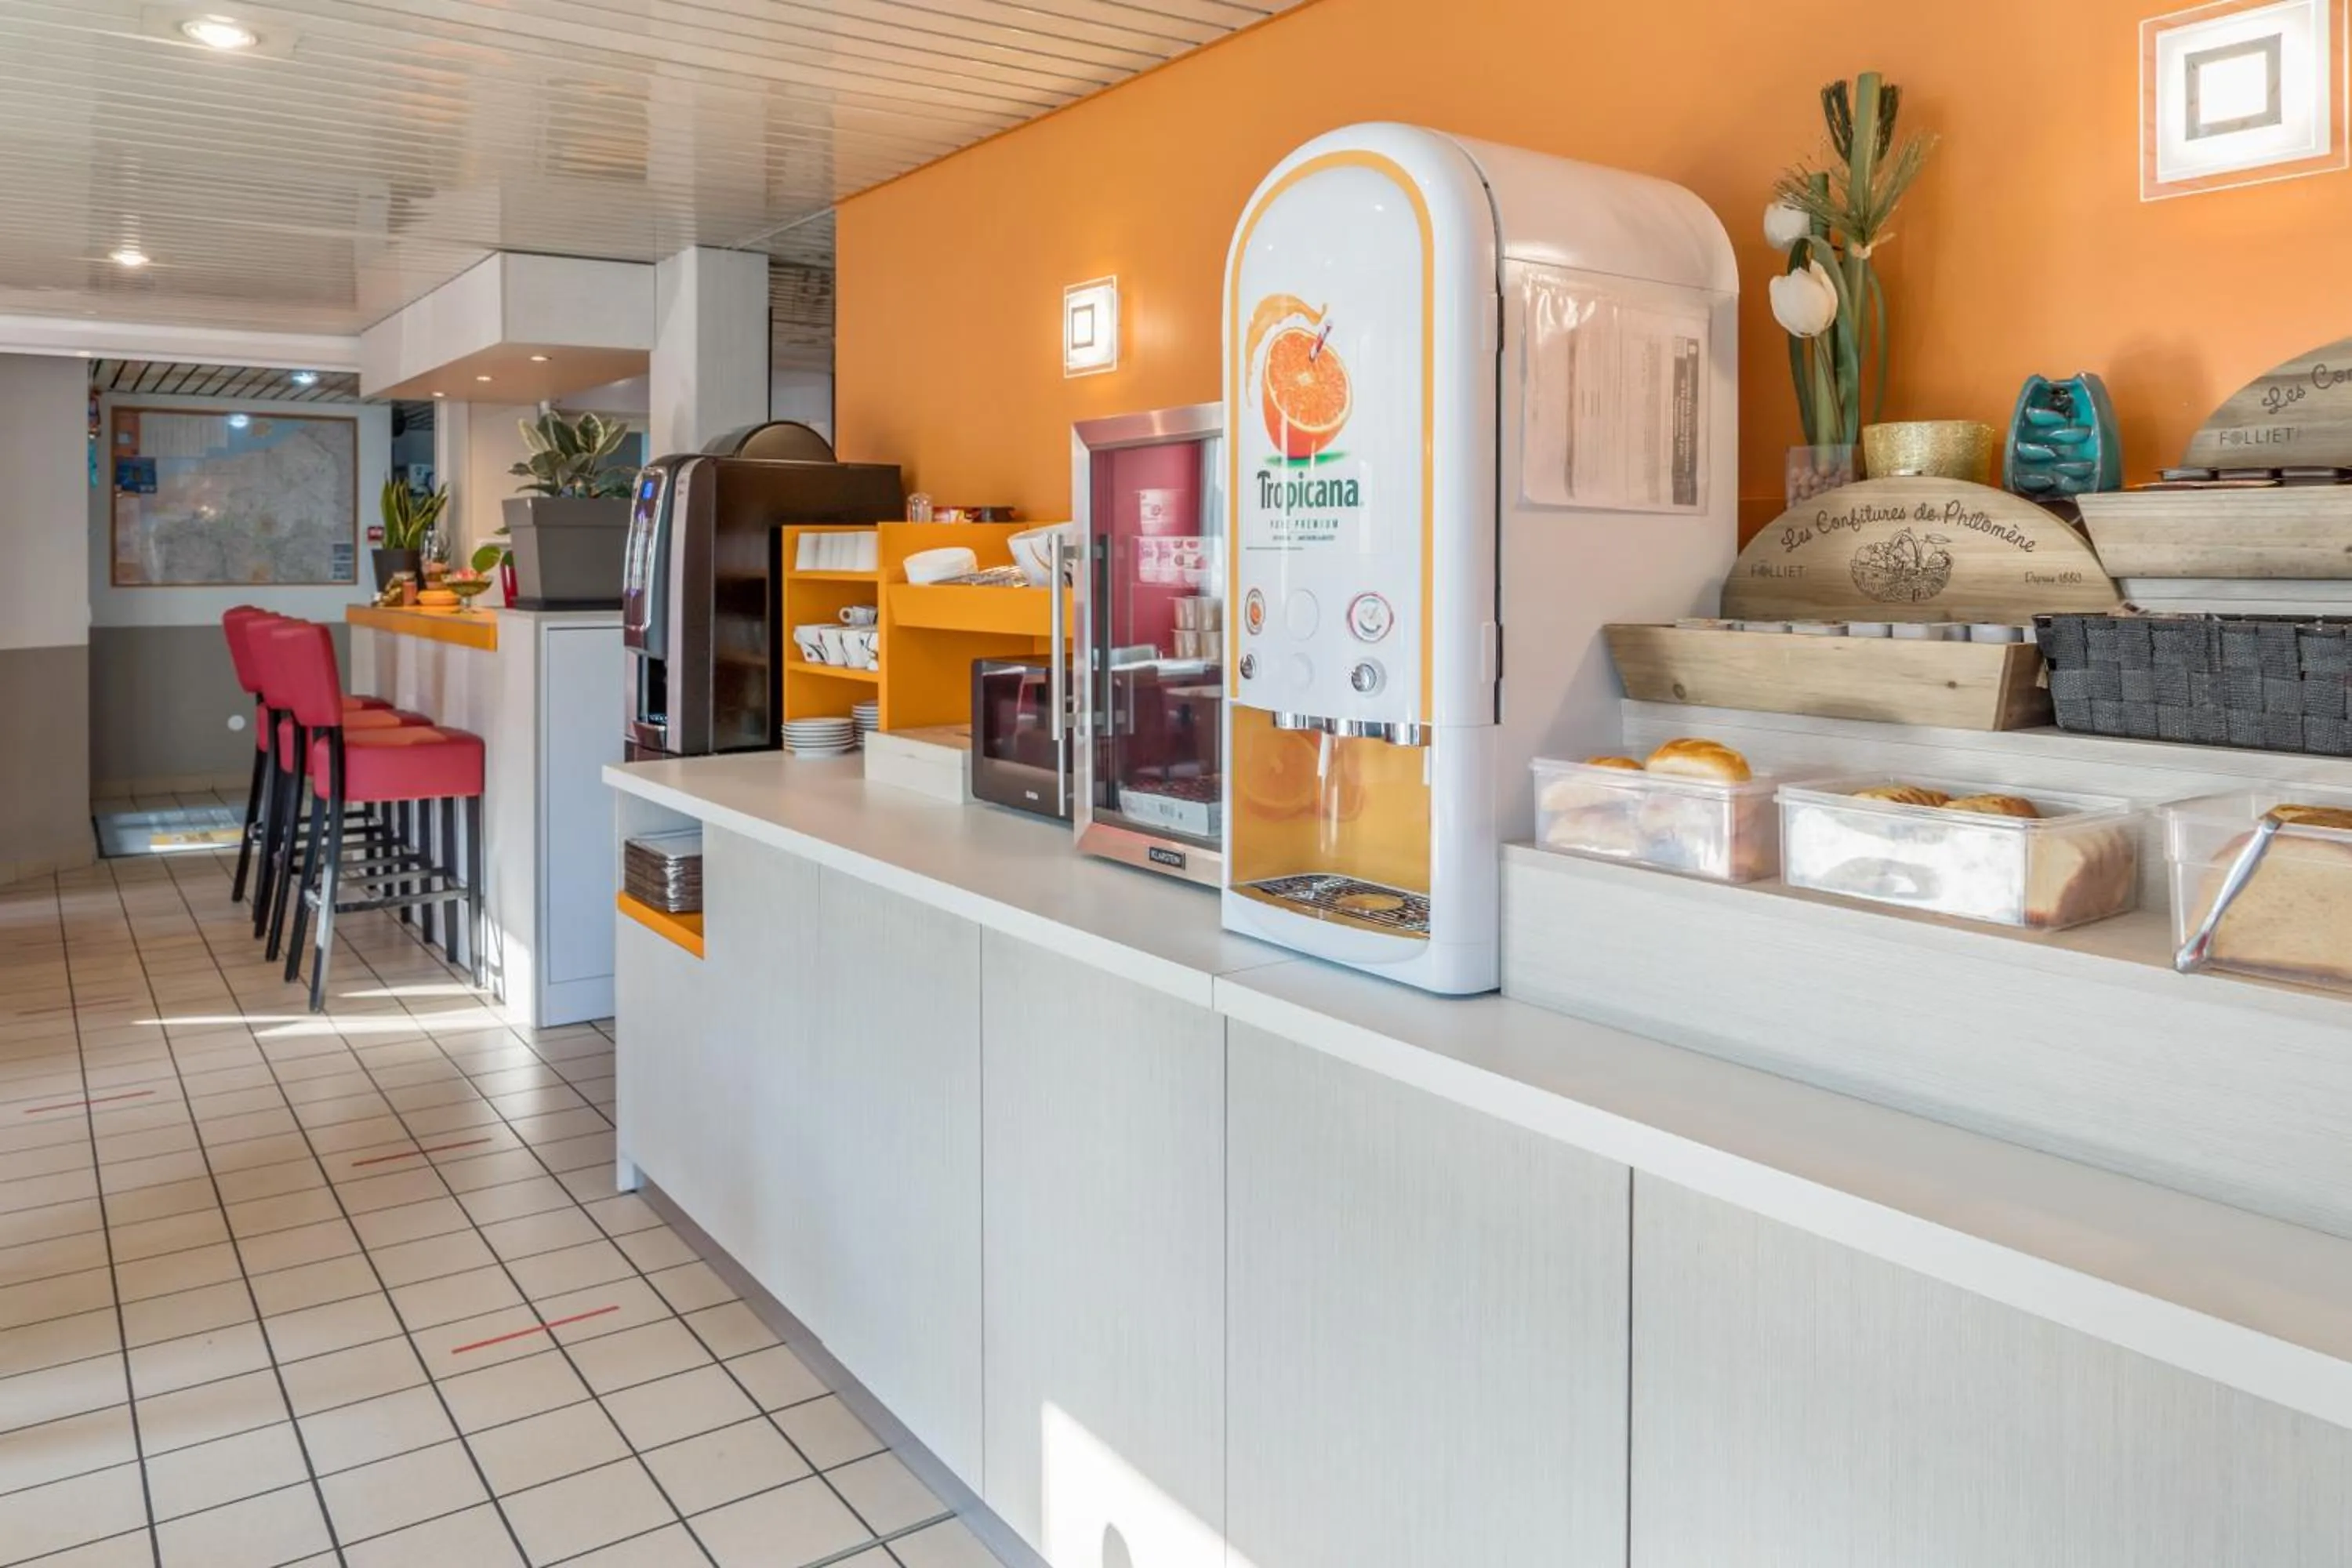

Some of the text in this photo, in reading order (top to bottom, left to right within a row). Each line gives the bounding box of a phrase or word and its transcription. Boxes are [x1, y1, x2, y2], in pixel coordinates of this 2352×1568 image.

[2262, 384, 2306, 414] Les
[2220, 427, 2295, 445] FOLLIET
[1257, 470, 1359, 516] Tropicana
[1781, 528, 1813, 553] Les
[1817, 506, 1906, 534] Confitures
[1944, 499, 2036, 553] Philomène
[1751, 563, 1806, 578] FOLLIET
